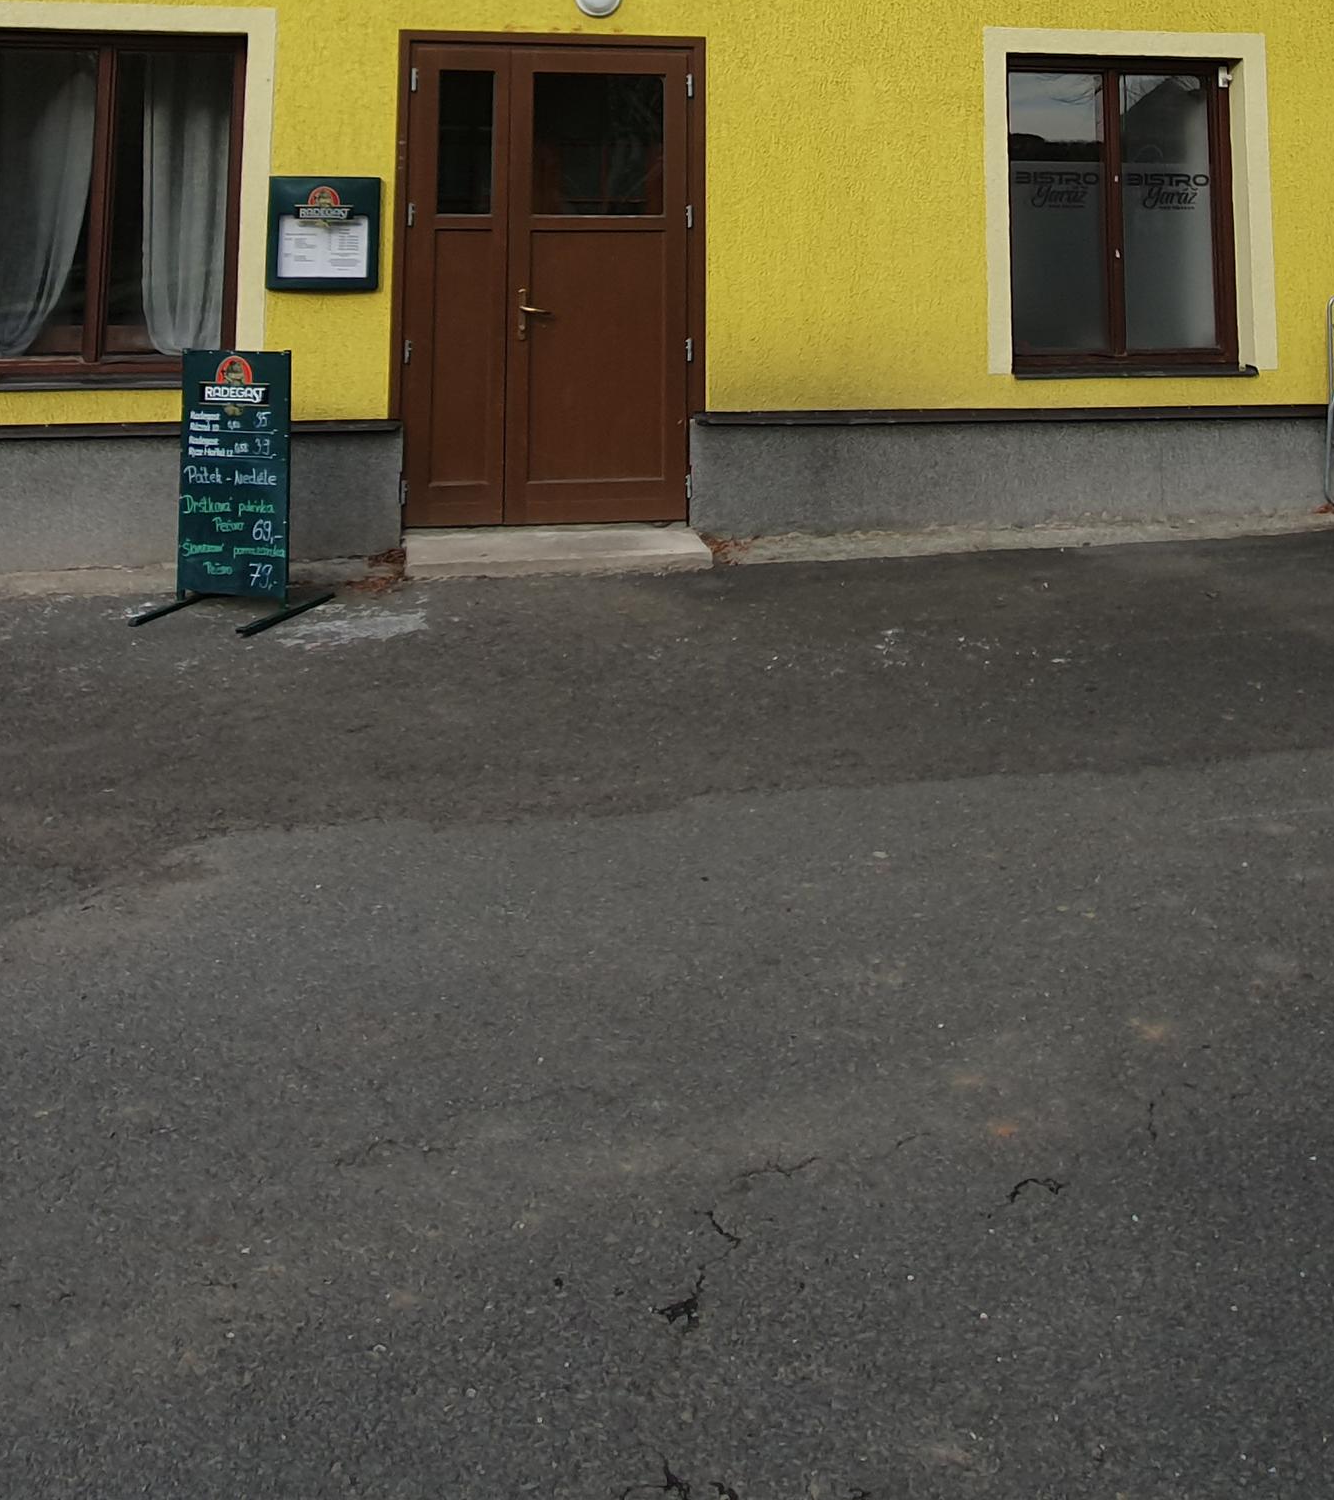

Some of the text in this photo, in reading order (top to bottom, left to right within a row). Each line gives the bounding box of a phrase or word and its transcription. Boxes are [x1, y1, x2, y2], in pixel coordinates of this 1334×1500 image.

[1014, 171, 1099, 185] BISTRO
[1126, 172, 1210, 187] BISTRO
[299, 208, 351, 219] RADEGAST
[204, 386, 267, 403] RADEGAST
[184, 465, 223, 484] Pátek
[252, 518, 284, 545] 69,-
